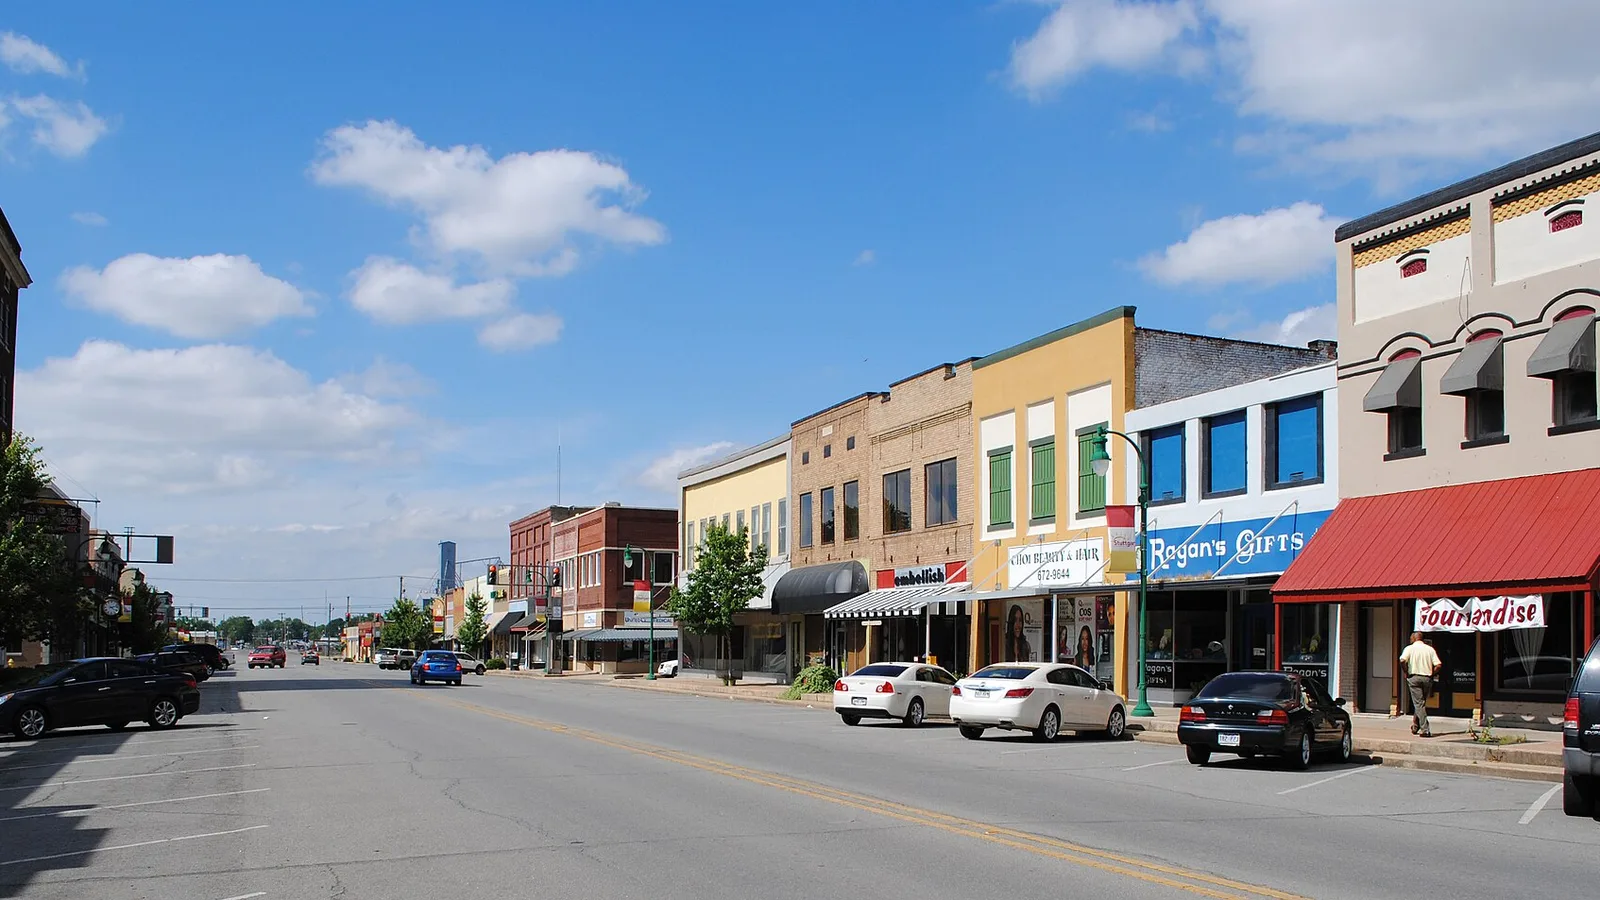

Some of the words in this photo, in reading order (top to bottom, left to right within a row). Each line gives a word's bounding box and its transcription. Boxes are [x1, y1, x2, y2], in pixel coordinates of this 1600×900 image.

[1011, 553, 1032, 565] CHOI
[1075, 547, 1099, 561] HAIR
[1149, 538, 1226, 570] Ragan's
[894, 567, 945, 587] embellish
[1037, 568, 1070, 581] 672-9644
[1145, 663, 1172, 675] agan's
